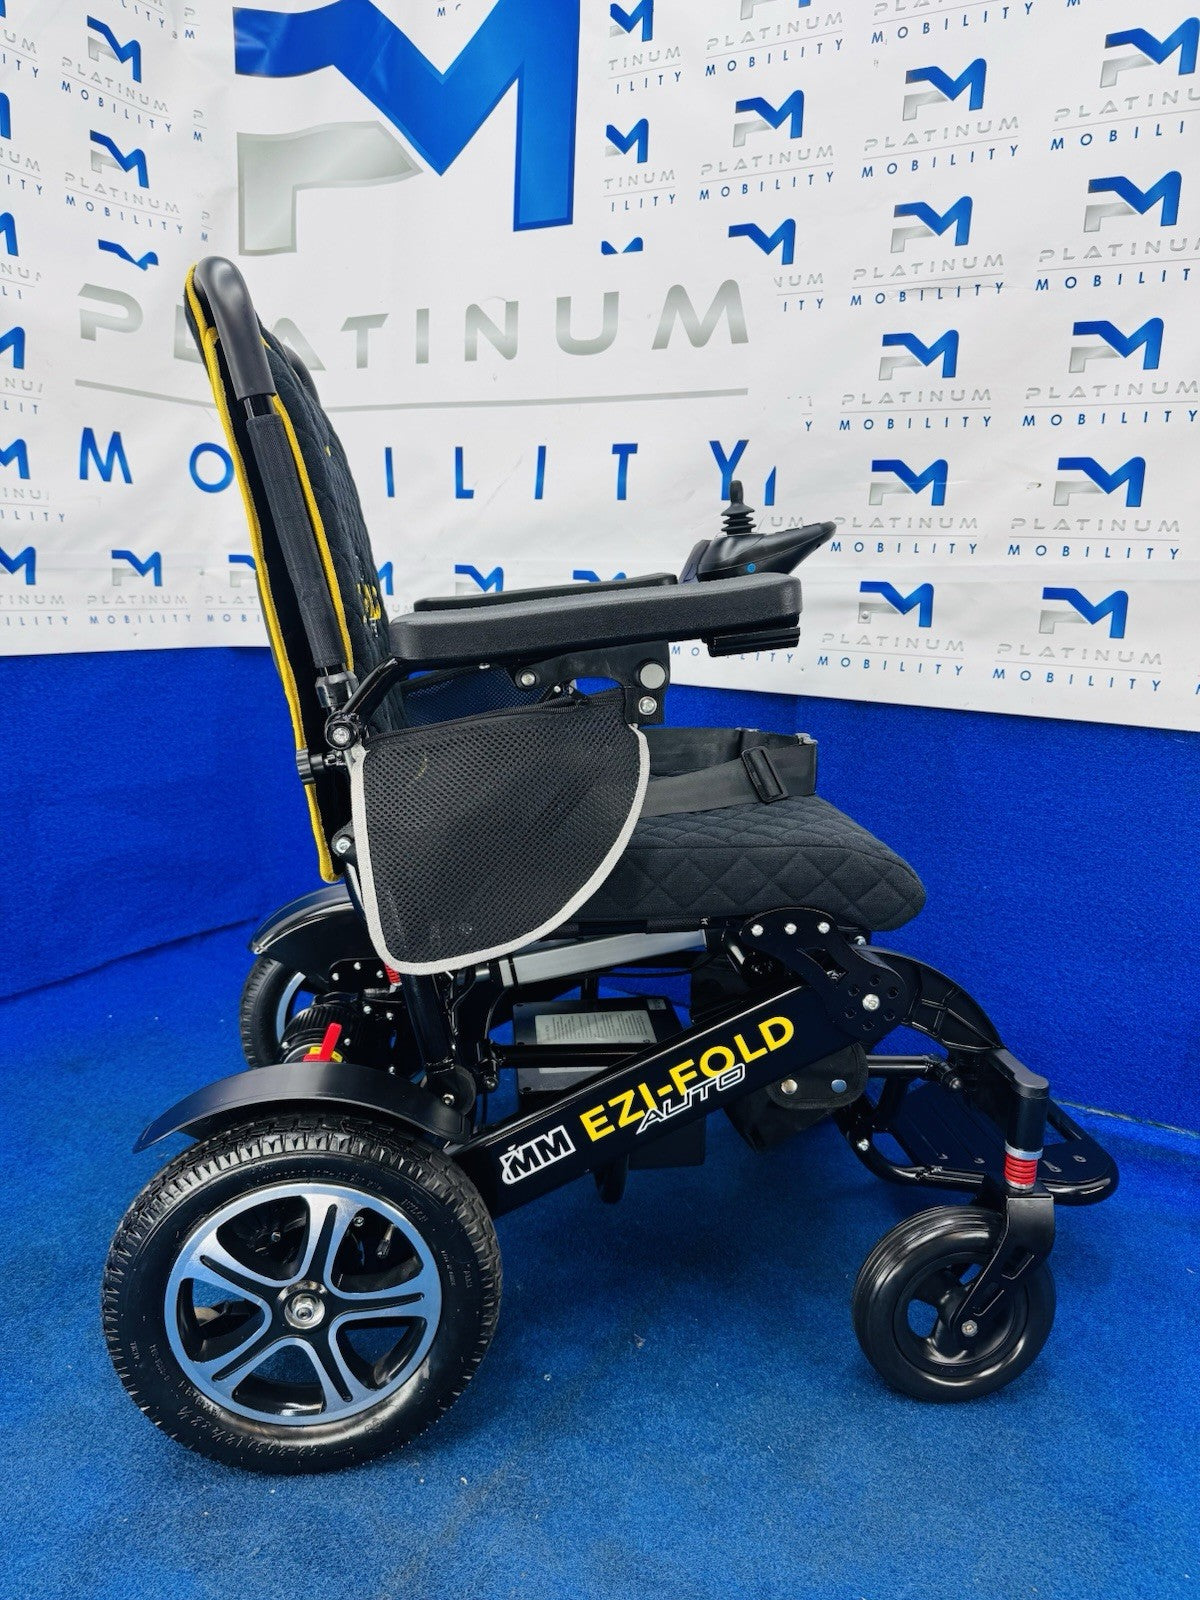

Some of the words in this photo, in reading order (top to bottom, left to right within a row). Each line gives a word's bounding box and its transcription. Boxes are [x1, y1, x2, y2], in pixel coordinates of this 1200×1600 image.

[706, 11, 843, 51] PLATINUM
[871, 2, 1034, 44] MOBILITY
[705, 38, 844, 77] MOBILITY
[60, 56, 169, 113] PLATINUM
[60, 80, 173, 133] MOBILITY
[863, 116, 1020, 152] PLATINUM
[700, 144, 834, 176] PLATINUM
[861, 144, 1019, 178] MOBILITY
[64, 172, 181, 213] PLATINUM
[699, 171, 834, 200] MOBILITY
[65, 195, 184, 234] MOBILITY
[852, 253, 1004, 281] PLATINUM
[849, 282, 1004, 306] MOBILITY
[841, 388, 992, 406] PLATINUM
[1025, 380, 1199, 400] PLATINUM
[839, 415, 992, 431] MOBILITY
[1022, 409, 1200, 428] MOBILITY
[79, 427, 749, 501] MOILITY
[834, 516, 978, 529] PLATINUM
[1010, 517, 1181, 533] PLATINUM
[830, 541, 978, 555] MOBILITY
[1007, 544, 1180, 560] MOBILITY
[87, 595, 189, 605] PLATINUM
[89, 613, 192, 625] MOBILITY
[820, 632, 965, 652] PLATINUM
[996, 643, 1163, 665] PLATINUM
[817, 655, 964, 677] MOBILITY
[991, 668, 1162, 692] MOBILITY
[580, 1015, 795, 1143] EZI-FOLD
[636, 1062, 748, 1135] AUTO
